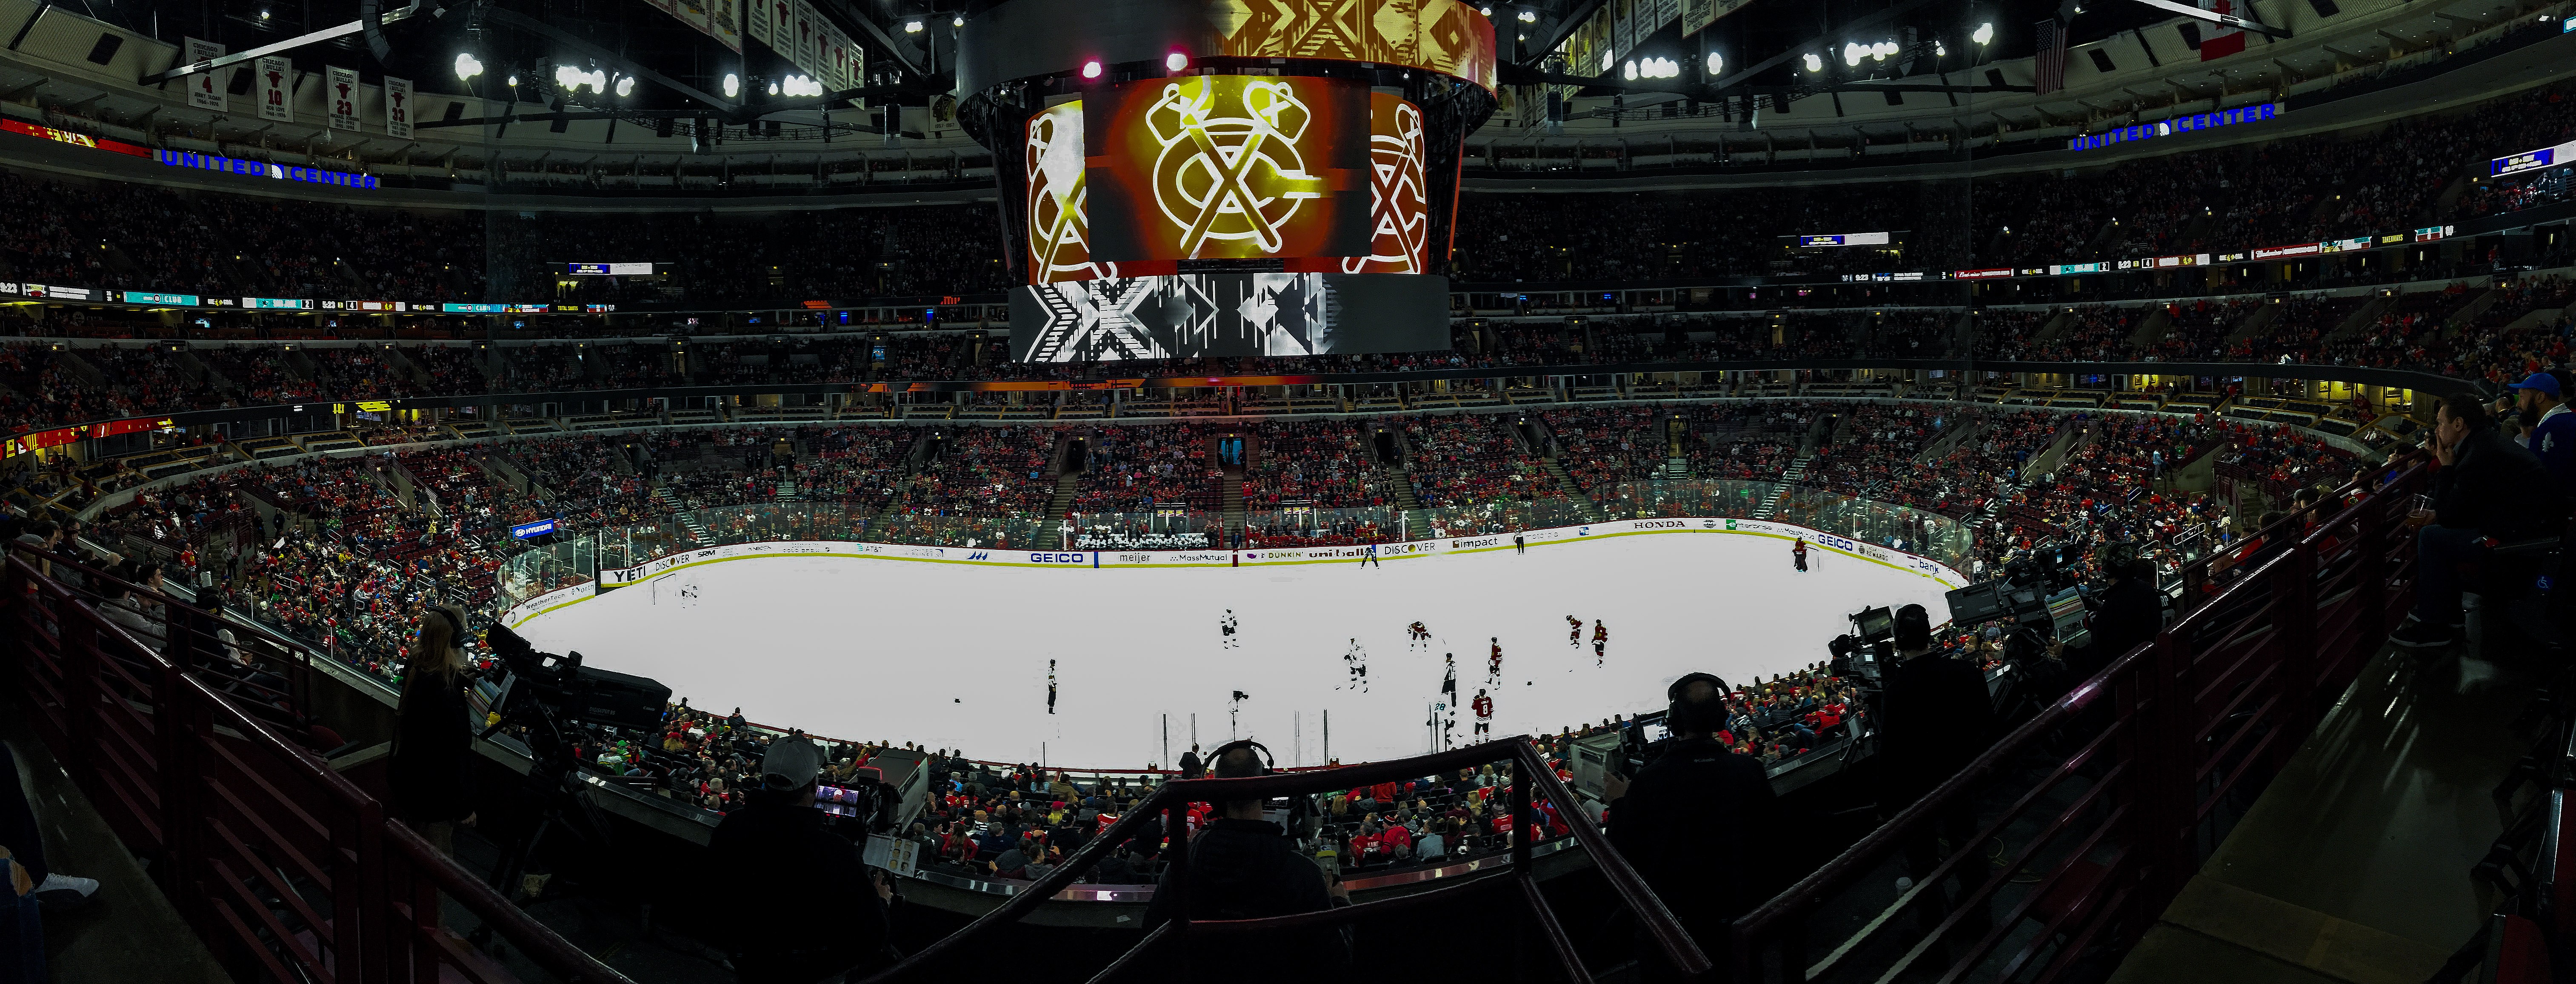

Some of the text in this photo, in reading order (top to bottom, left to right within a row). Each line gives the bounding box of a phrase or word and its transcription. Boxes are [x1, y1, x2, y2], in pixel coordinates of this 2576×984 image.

[193, 43, 218, 52] CHICAGO
[197, 49, 214, 57] BULLS
[262, 58, 284, 66] CHICAGO
[333, 71, 353, 79] CHICAGO
[202, 76, 212, 94] 4
[388, 80, 406, 88] CHICAGO
[268, 89, 282, 106] 10
[337, 99, 352, 116] 23
[392, 107, 405, 123] 33
[2073, 103, 2276, 151] UNITED CENTER
[161, 149, 377, 190] UNITED CENTER
[2382, 234, 2403, 243] TAKEAWAYS
[525, 523, 552, 535] HYUNDAI
[1634, 521, 1686, 529] HONDA
[1385, 542, 1435, 555] DISCOVER
[1460, 537, 1498, 549] impact
[1818, 534, 1853, 551] GEICO
[698, 549, 716, 558] SRM
[1031, 553, 1084, 563] GEICO
[1120, 552, 1150, 564] meijer
[655, 554, 690, 571] DISCOVER
[1919, 559, 1939, 574] bank
[613, 565, 646, 583] YETI
[526, 593, 565, 610] WeatherTech
[1434, 703, 1446, 711] 28
[1483, 704, 1488, 715] 8
